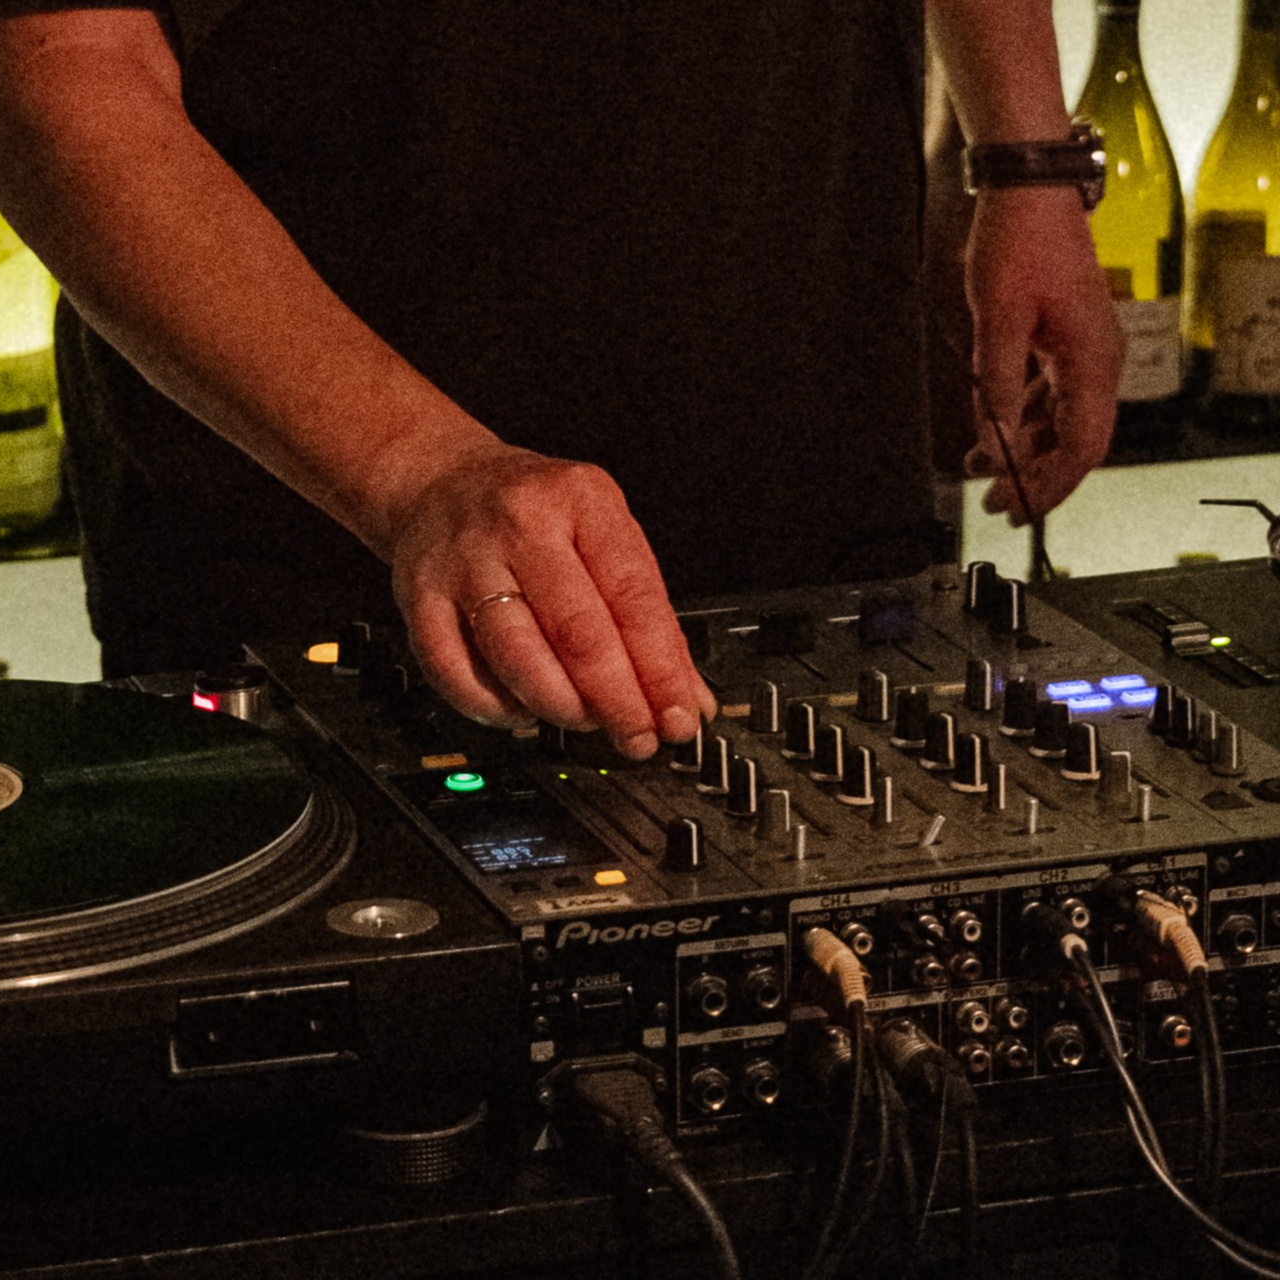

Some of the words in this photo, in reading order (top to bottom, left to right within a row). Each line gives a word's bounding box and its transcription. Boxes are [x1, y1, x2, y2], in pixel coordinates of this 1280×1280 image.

[1039, 869, 1069, 883] CH2
[930, 882, 961, 895] CH3
[820, 895, 851, 908] CH4
[947, 897, 963, 908] CD
[797, 912, 831, 924] PHONO
[837, 909, 853, 921] CD
[555, 915, 721, 949] Pioneer
[575, 972, 622, 989] POWER
